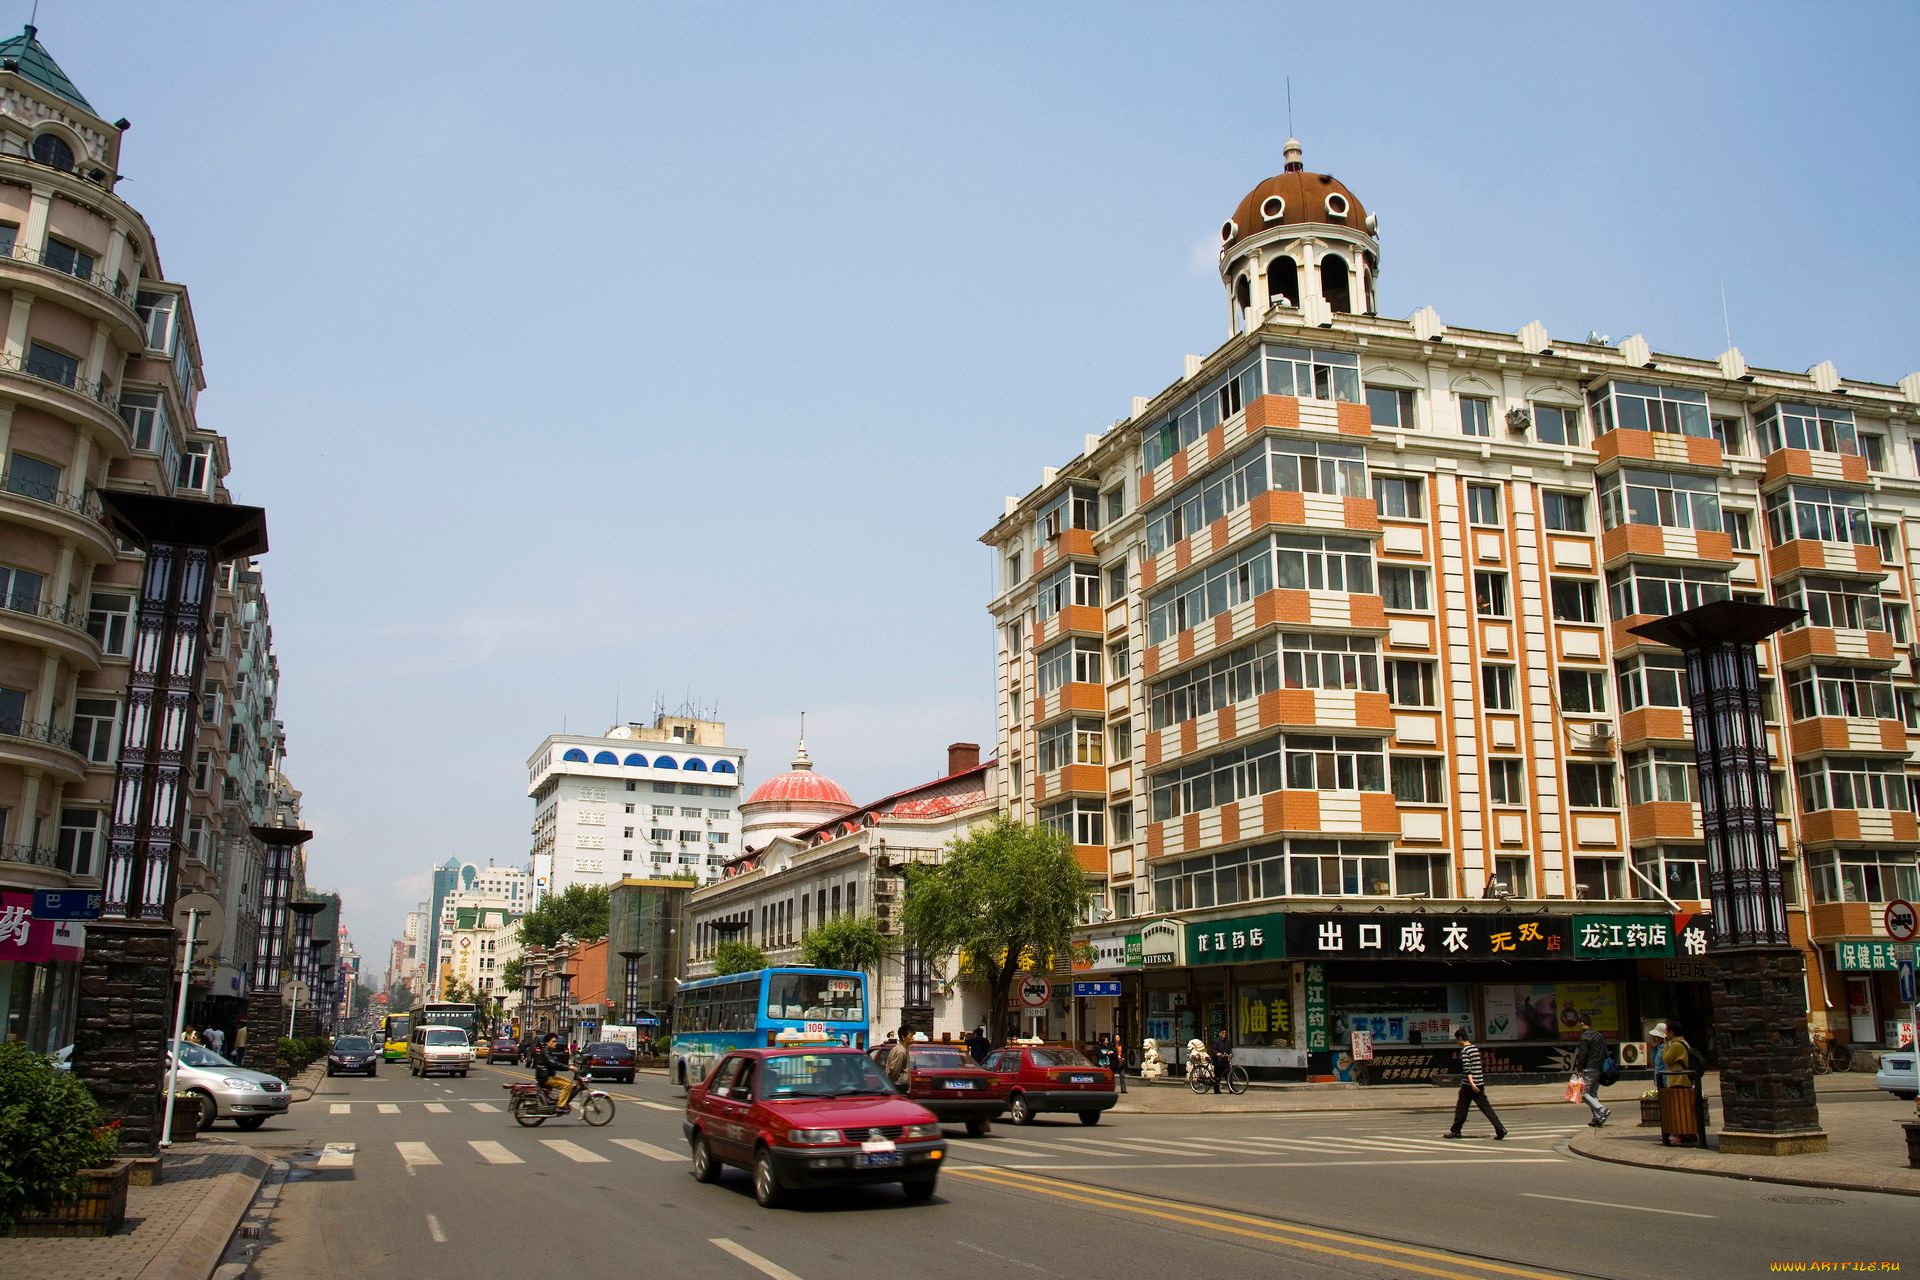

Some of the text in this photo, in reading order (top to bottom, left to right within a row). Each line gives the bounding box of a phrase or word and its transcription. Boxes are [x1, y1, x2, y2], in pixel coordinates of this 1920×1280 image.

[0, 906, 32, 946] 药
[1318, 921, 1561, 953] 出口成衣 无双 店
[1580, 922, 1667, 948] 龙江药店
[1197, 928, 1265, 952] 龙江药店
[1143, 954, 1172, 964] АПТЕКА
[834, 982, 849, 990] 109
[1306, 965, 1326, 1048] 龙江药店
[808, 1023, 823, 1033] 109
